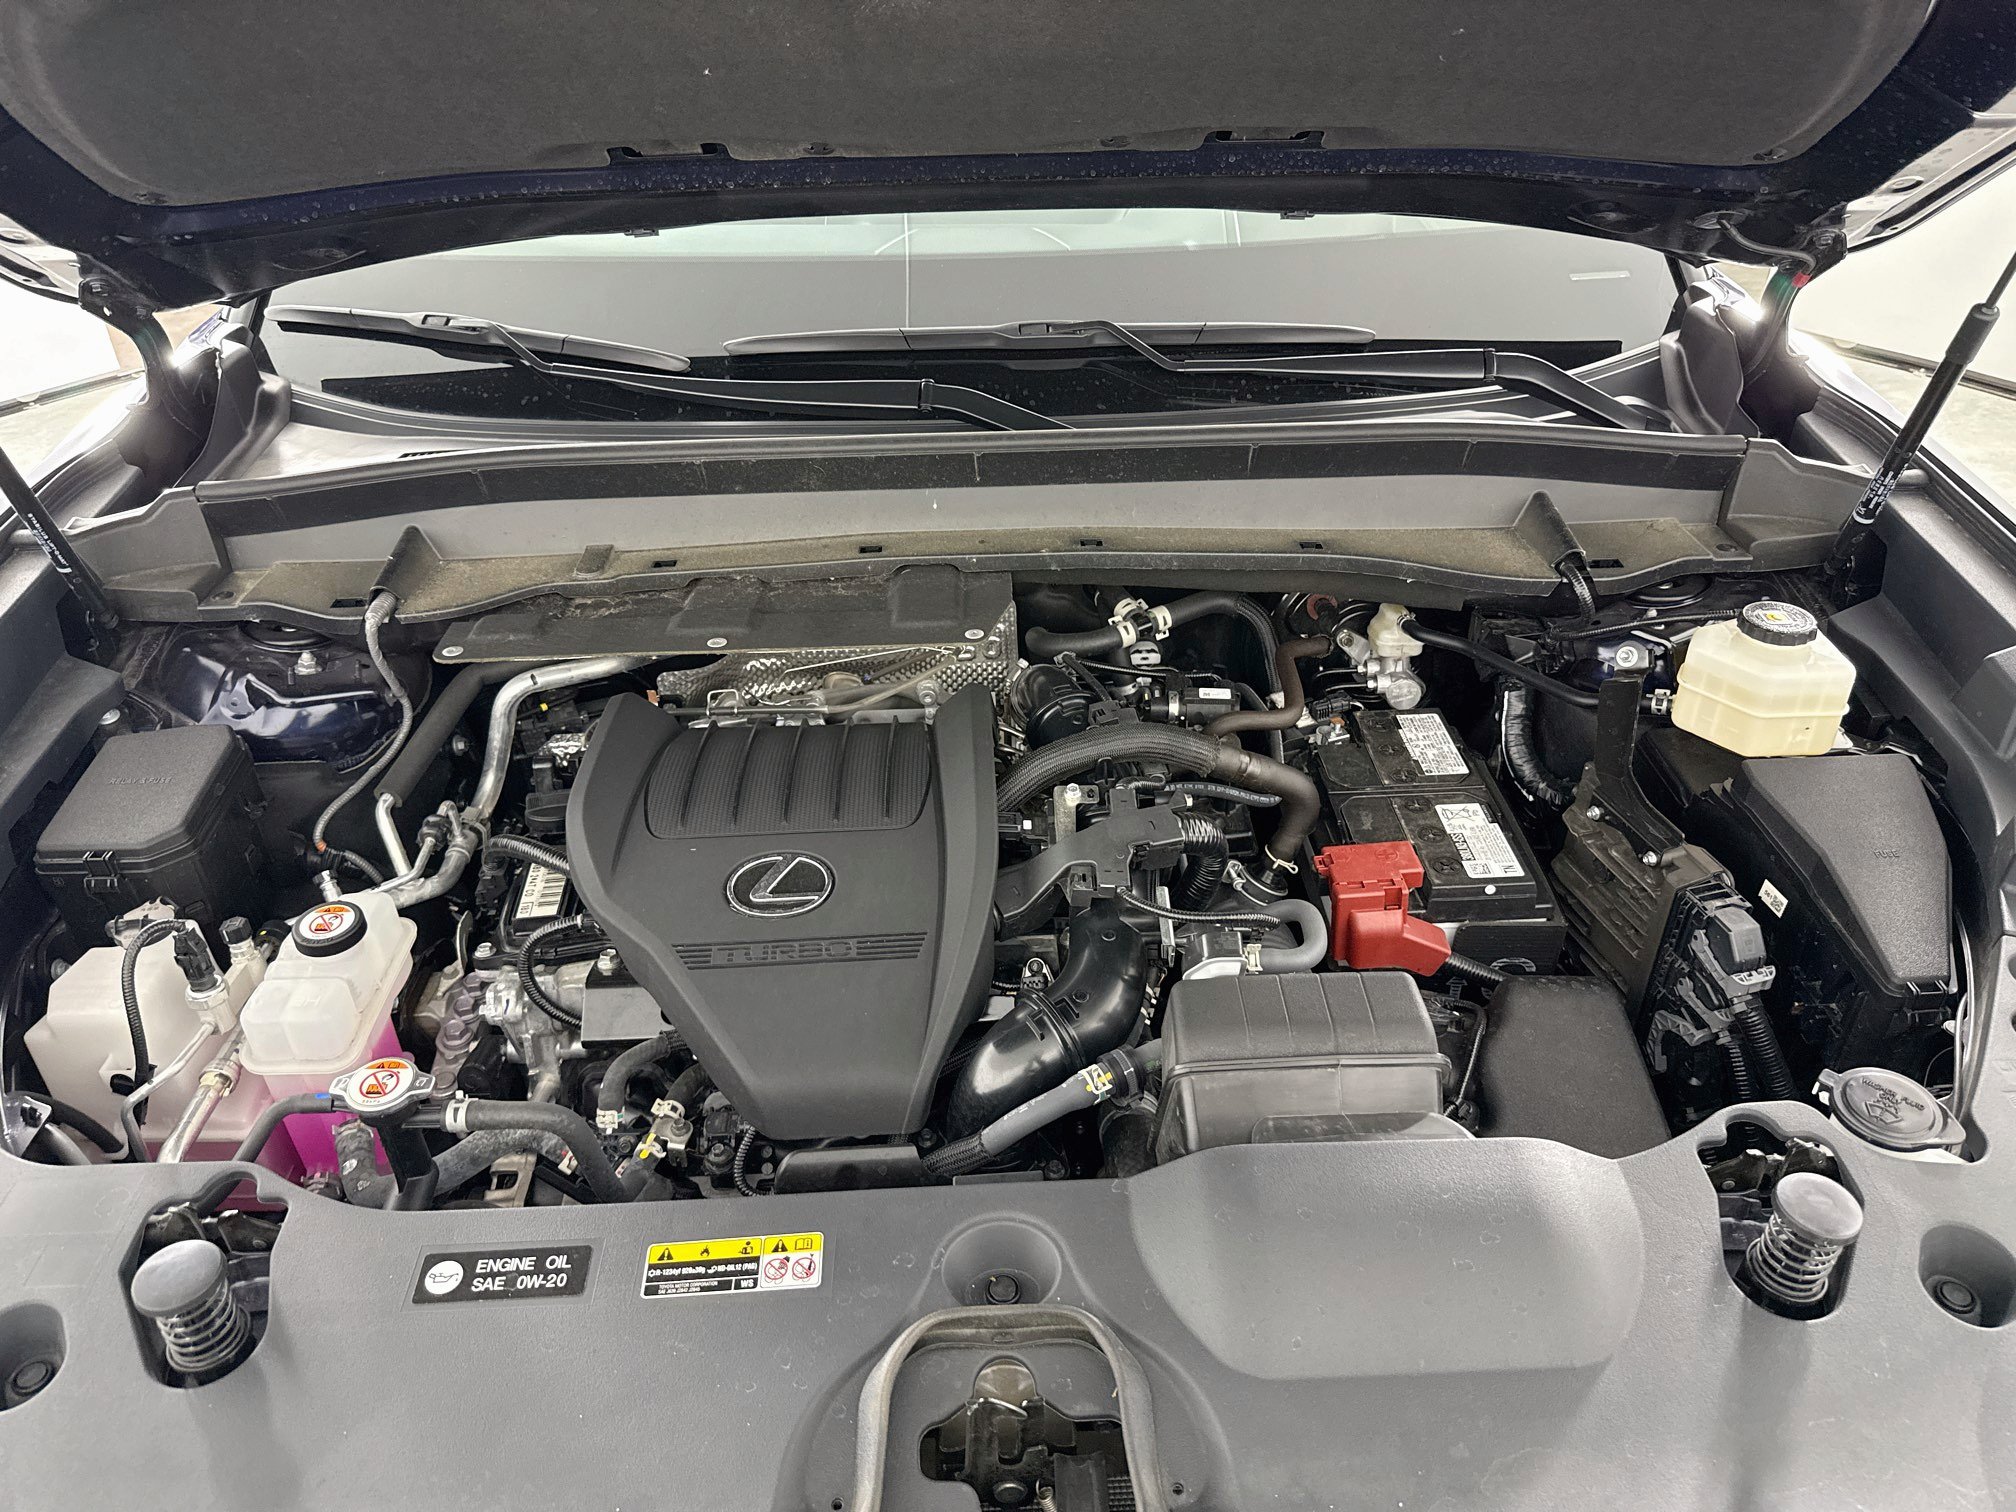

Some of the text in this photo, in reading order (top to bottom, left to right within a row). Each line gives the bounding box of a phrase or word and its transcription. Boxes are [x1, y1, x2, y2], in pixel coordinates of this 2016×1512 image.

[1872, 849, 1901, 859] FUSE
[716, 941, 852, 962] TURBO
[475, 1254, 572, 1274] ENGINE OIL
[471, 1273, 568, 1292] SAE 0W-20
[740, 1280, 754, 1289] WS
